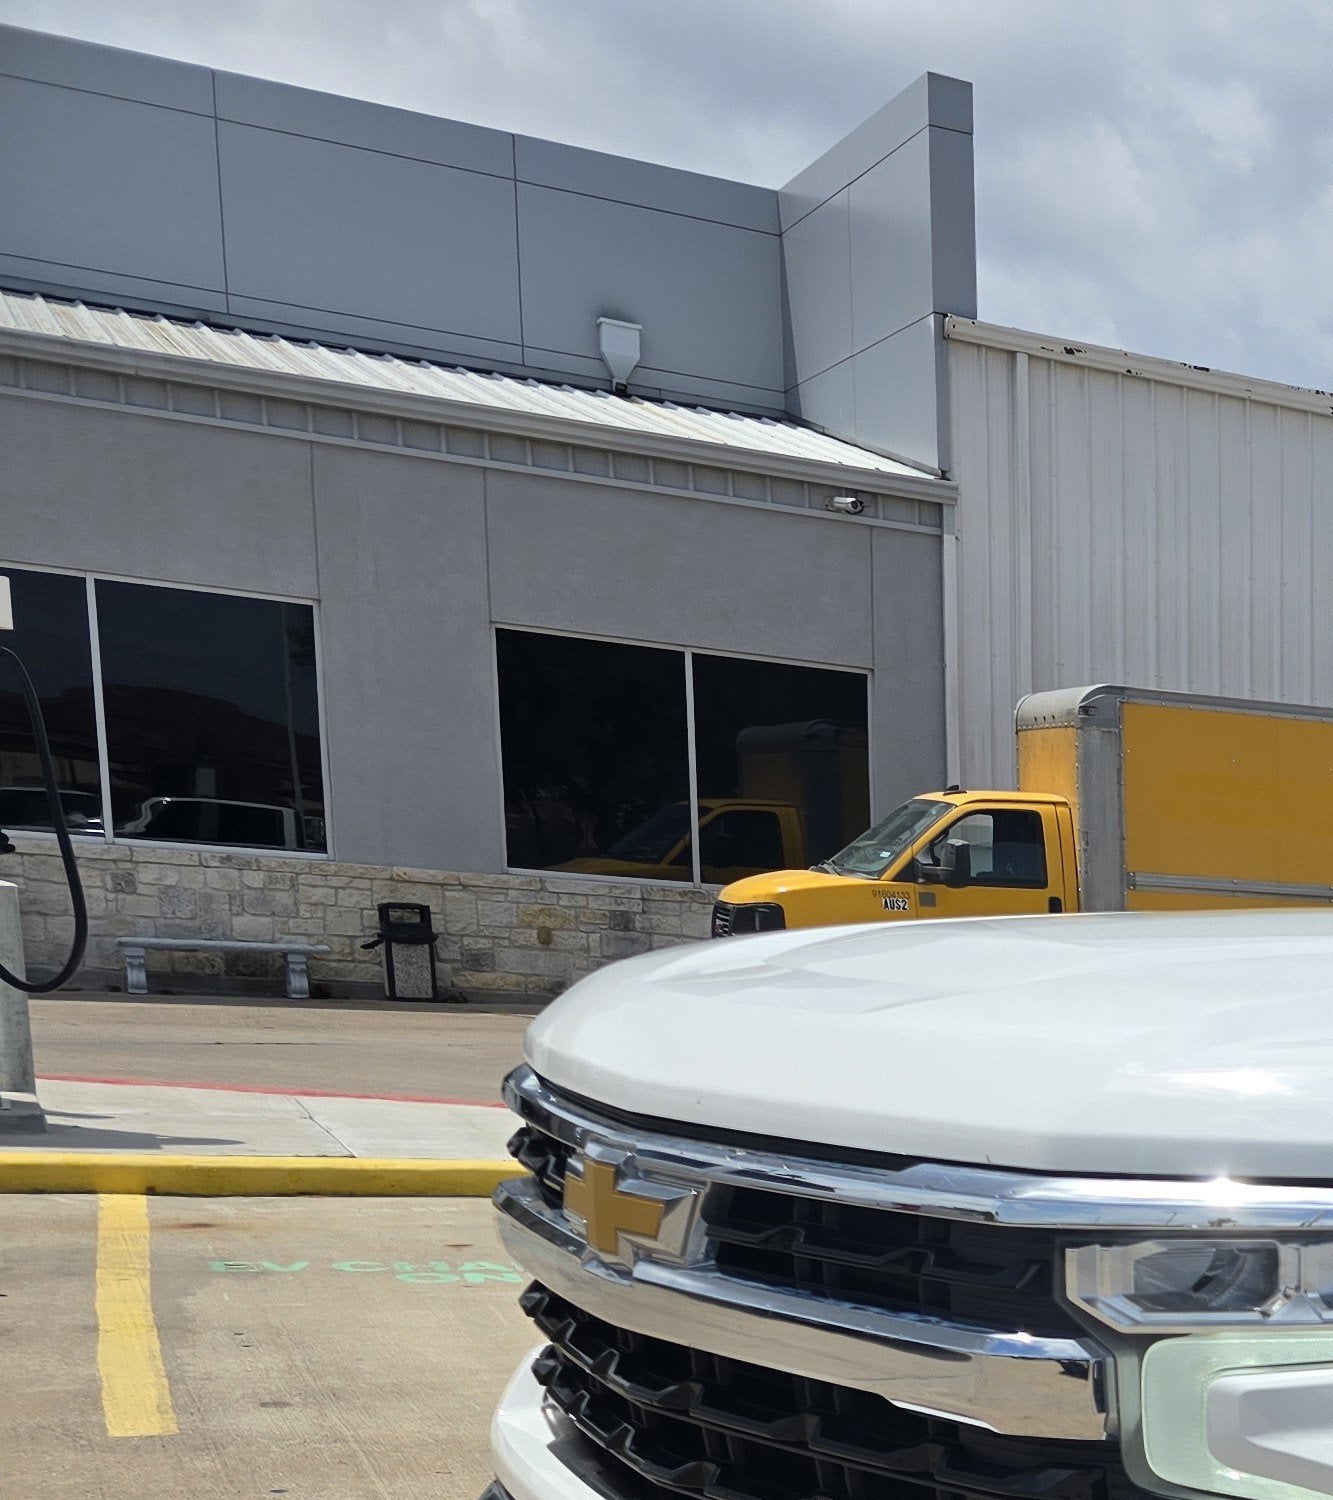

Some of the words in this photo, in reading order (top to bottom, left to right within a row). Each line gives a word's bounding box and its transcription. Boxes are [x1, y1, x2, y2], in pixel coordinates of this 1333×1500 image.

[884, 898, 907, 910] AUS2
[209, 1261, 309, 1272] EV
[331, 1261, 514, 1272] CHA
[395, 1273, 523, 1284] ON
